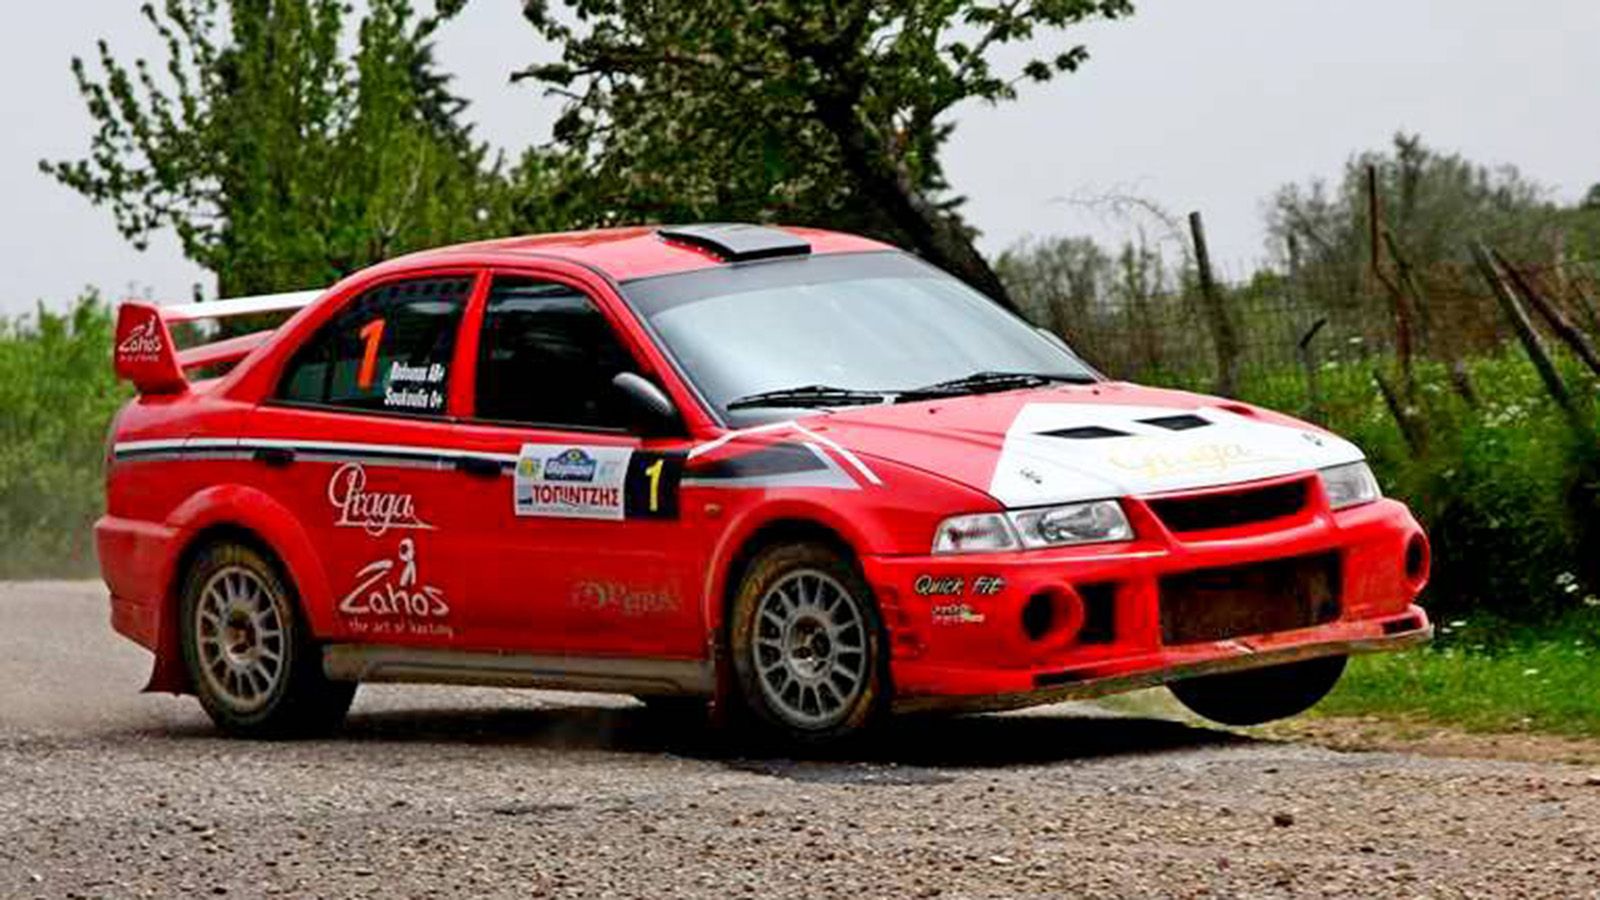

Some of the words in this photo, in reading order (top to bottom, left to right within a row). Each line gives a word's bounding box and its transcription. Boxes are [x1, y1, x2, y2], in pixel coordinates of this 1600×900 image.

[358, 318, 386, 390] 1
[328, 462, 439, 537] Praga
[533, 484, 619, 507] ΤΟΠΙΝΤΖΗΣ
[645, 458, 665, 512] 1
